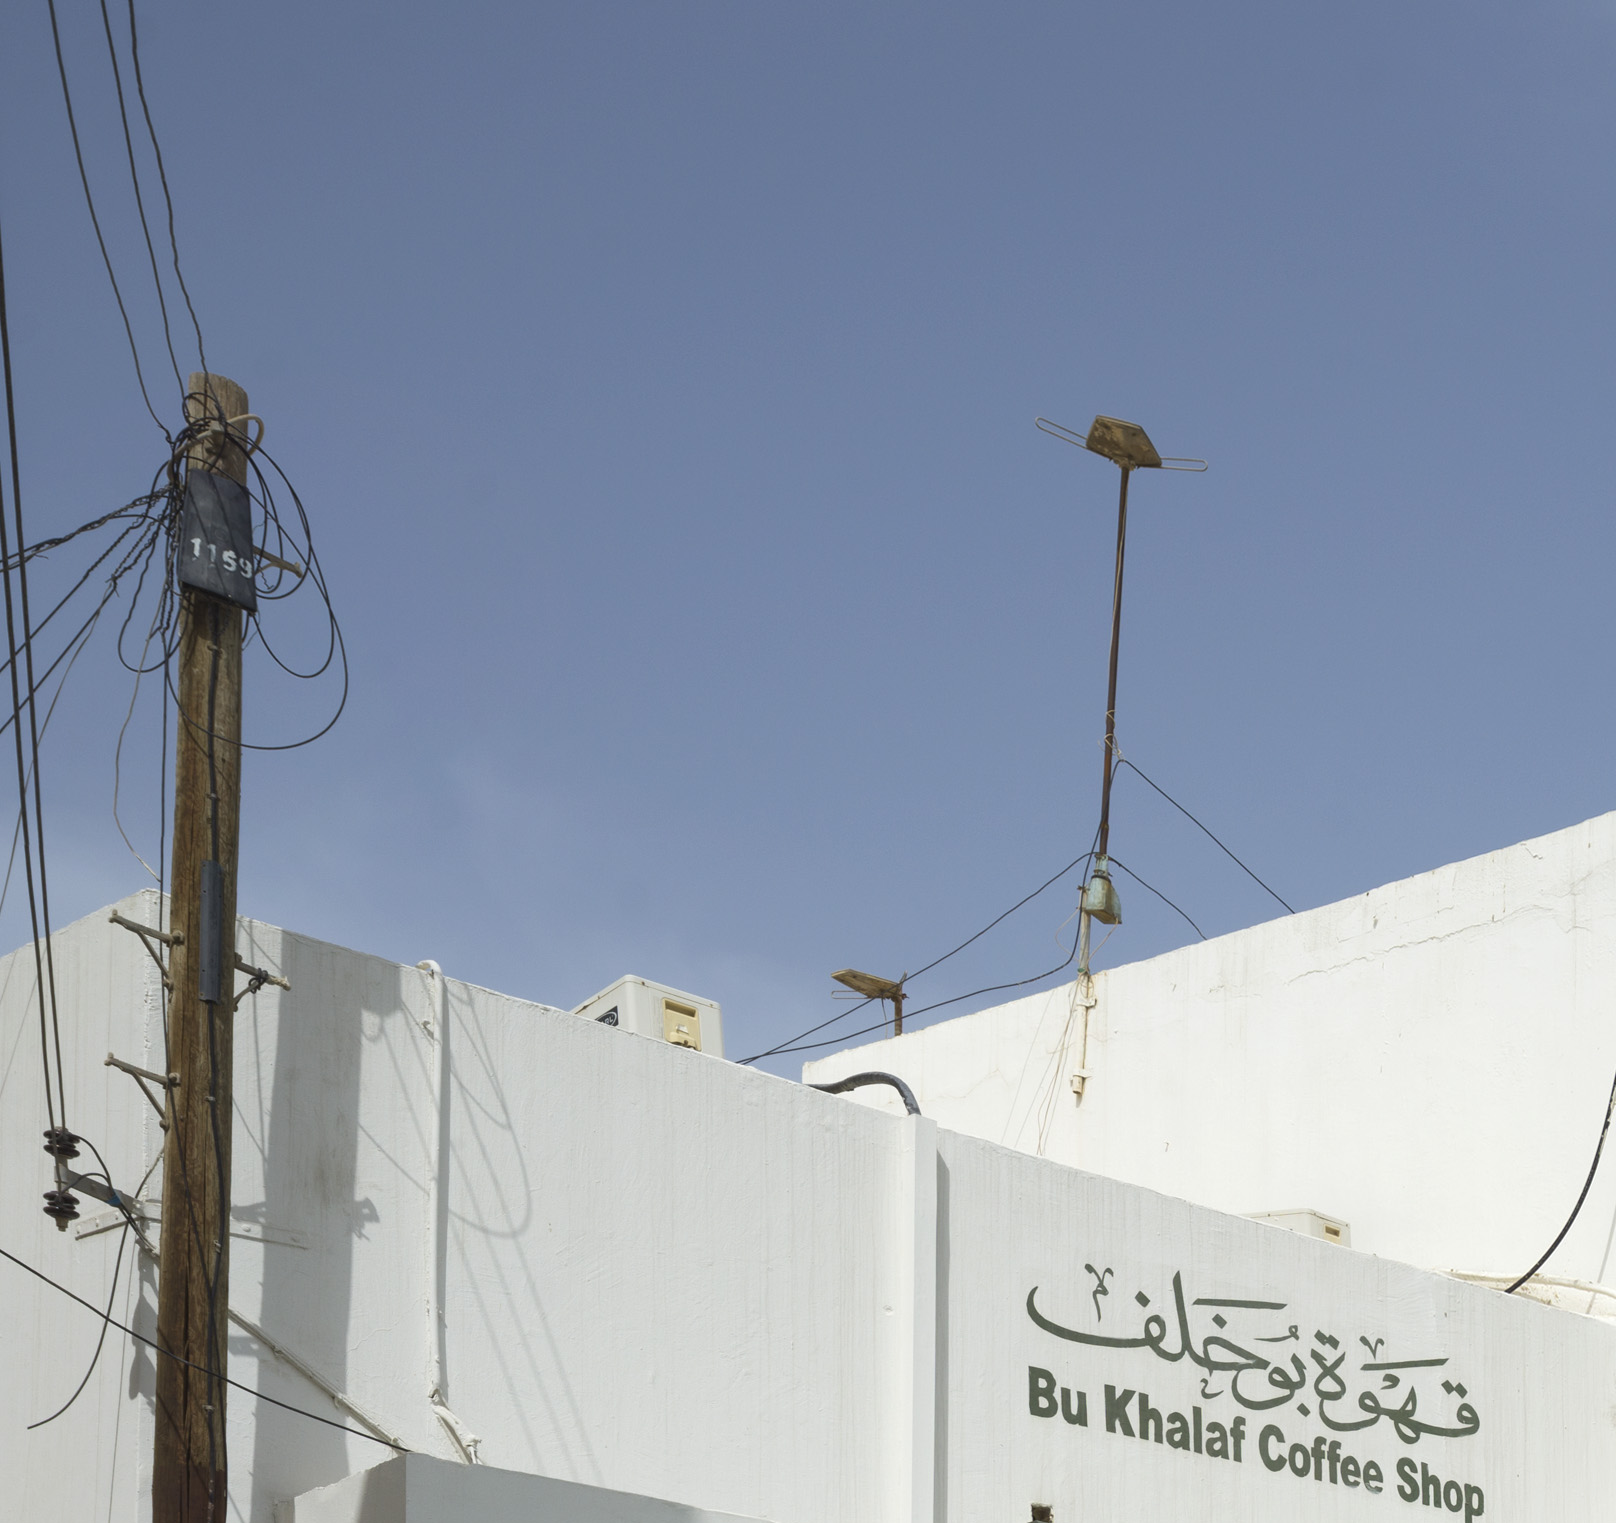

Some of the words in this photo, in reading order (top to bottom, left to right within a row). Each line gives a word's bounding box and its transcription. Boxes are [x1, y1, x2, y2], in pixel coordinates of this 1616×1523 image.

[190, 537, 253, 579] 1159
[1028, 1366, 1088, 1427] Bu
[1104, 1384, 1246, 1463] Khalaf
[1259, 1424, 1384, 1494] Coffee
[1310, 1329, 1480, 1445] قهوة
